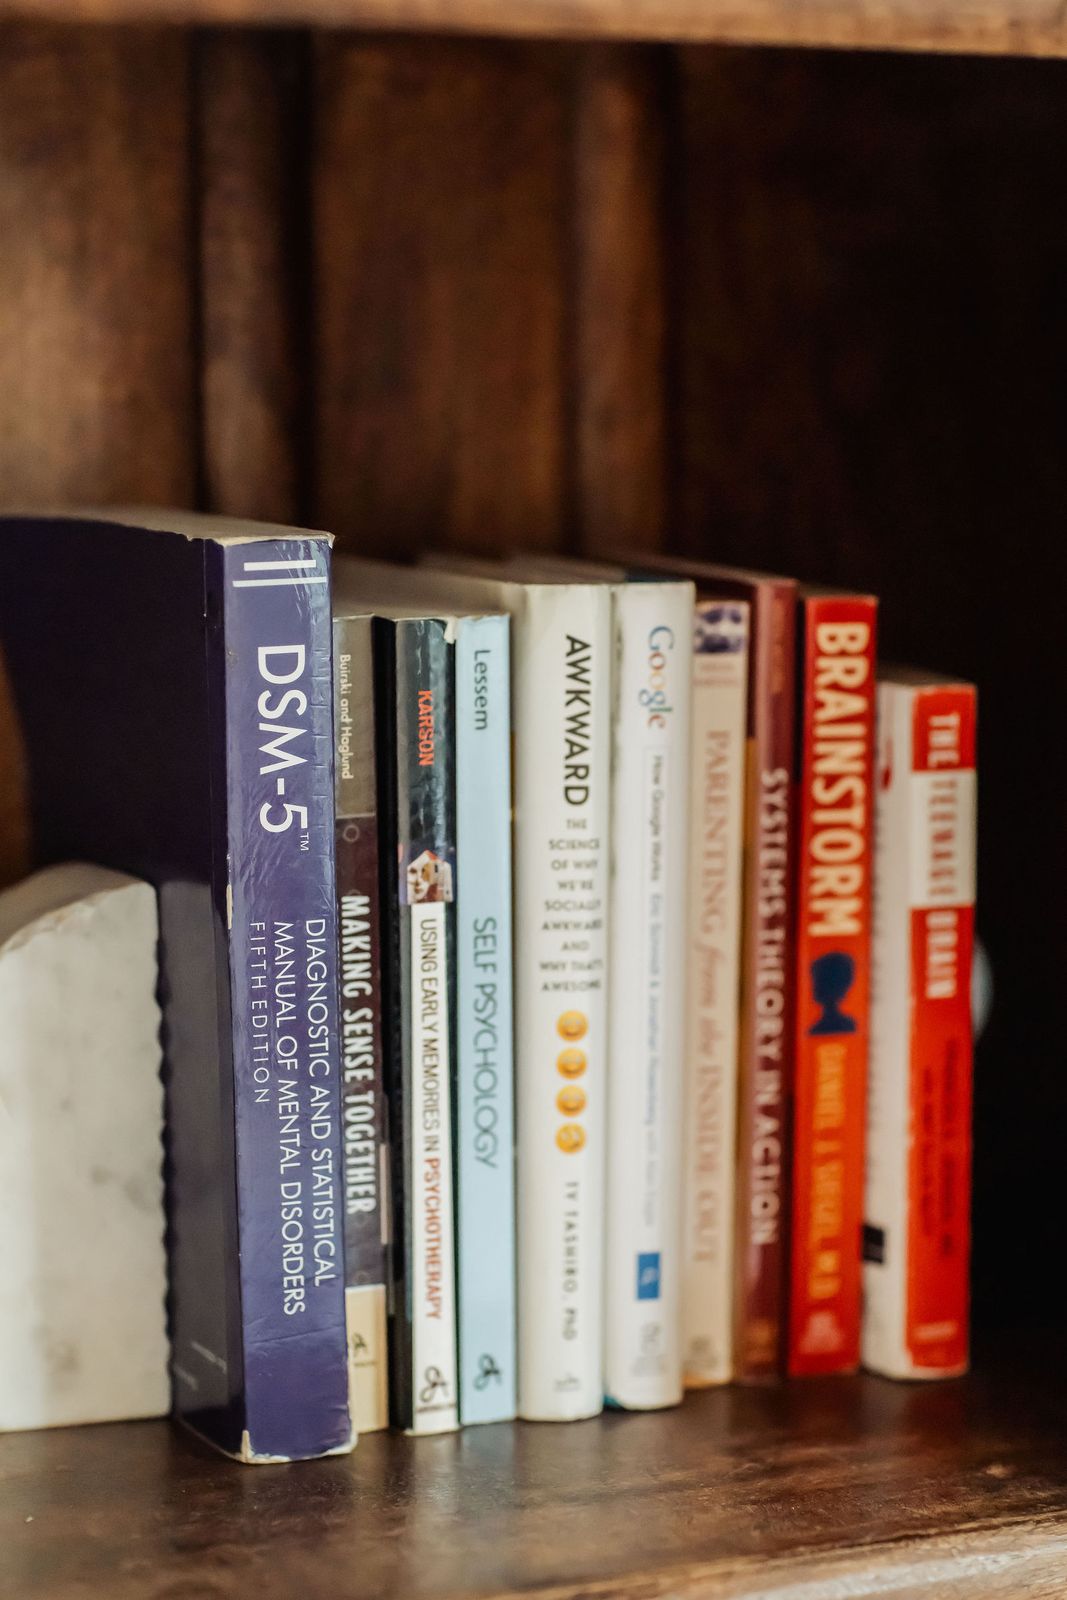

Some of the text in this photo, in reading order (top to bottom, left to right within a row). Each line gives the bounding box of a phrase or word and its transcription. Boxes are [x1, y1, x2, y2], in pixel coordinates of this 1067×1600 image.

[338, 653, 354, 780] Buirski and Haglund
[418, 690, 436, 767] KARSON
[473, 649, 490, 731] Lessem
[563, 634, 591, 806] AWKWARD
[638, 625, 674, 729] Google
[550, 860, 568, 871] OF
[566, 818, 587, 830] THE
[702, 729, 732, 933] PARENTING
[808, 622, 870, 937] BRAINSTORM
[249, 922, 270, 1103] FIFTH EDITION
[340, 895, 377, 1214] MAKING SENSE TOGETHER
[472, 916, 499, 1169] SELF PSYCHOLOGY
[751, 767, 789, 1245] SYSTEMS THEORY IN ACTION
[273, 921, 306, 1315] MANUAL OF MENTAL DISORDERS
[305, 918, 337, 1288] DIAGNOSTIC AND STATISTICAL
[420, 917, 442, 1320] USING EARLY MEMORIES IN PSYCHOTHERAPY
